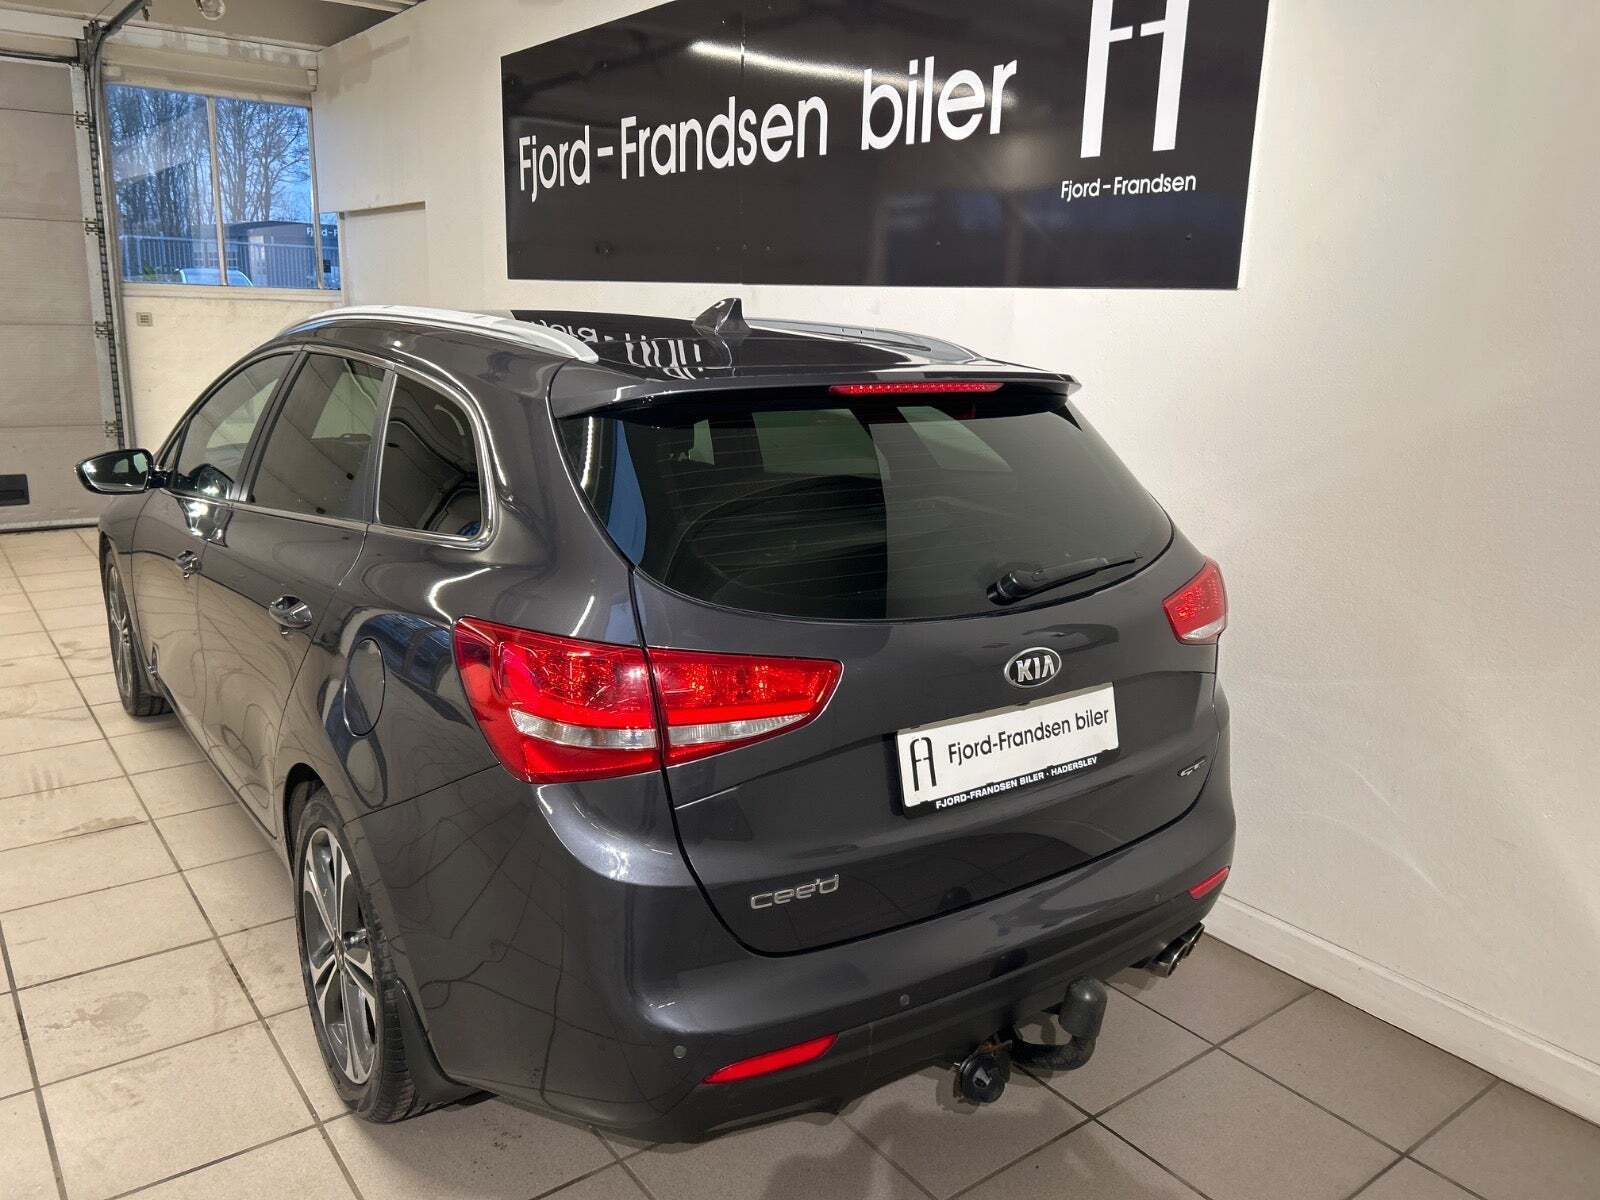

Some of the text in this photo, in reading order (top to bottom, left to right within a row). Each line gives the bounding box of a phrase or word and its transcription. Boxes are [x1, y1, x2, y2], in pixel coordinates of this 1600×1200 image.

[861, 57, 1018, 151] biler
[1016, 654, 1055, 682] KIA
[948, 718, 1071, 766] Fjord-Frandsen
[1075, 709, 1109, 731] biler
[935, 756, 1098, 809] FJORD-FRANDSEN BILER HADERSLEV
